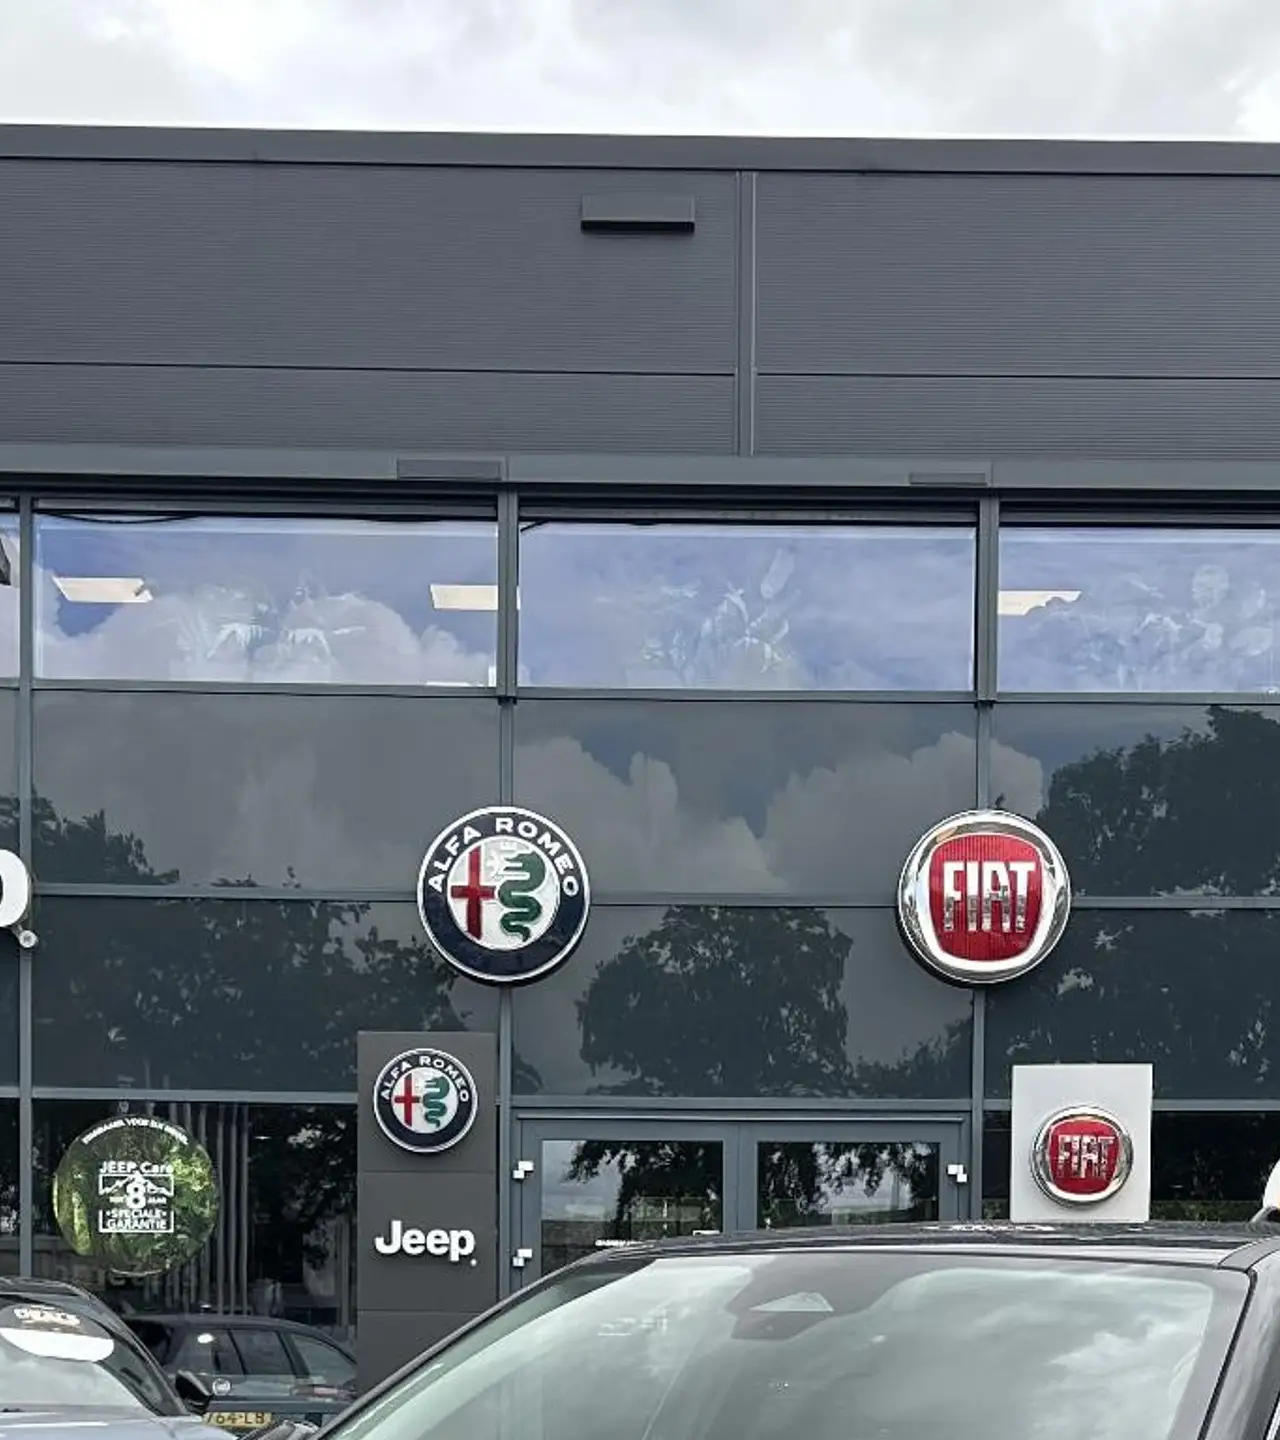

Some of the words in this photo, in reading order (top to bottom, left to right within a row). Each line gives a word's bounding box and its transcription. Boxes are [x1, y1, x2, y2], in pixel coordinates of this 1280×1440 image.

[428, 825, 482, 893] ALFA
[495, 817, 580, 897] ROMEO
[942, 861, 1037, 933] FIAT
[380, 1060, 413, 1101] ALFA
[419, 1055, 470, 1102] ROMEO
[99, 1161, 137, 1173] JEEP
[1057, 1134, 1115, 1179] FIAT
[126, 1181, 146, 1210] 8
[106, 1219, 167, 1230] GARANTIE
[374, 1220, 476, 1266] Jeep
